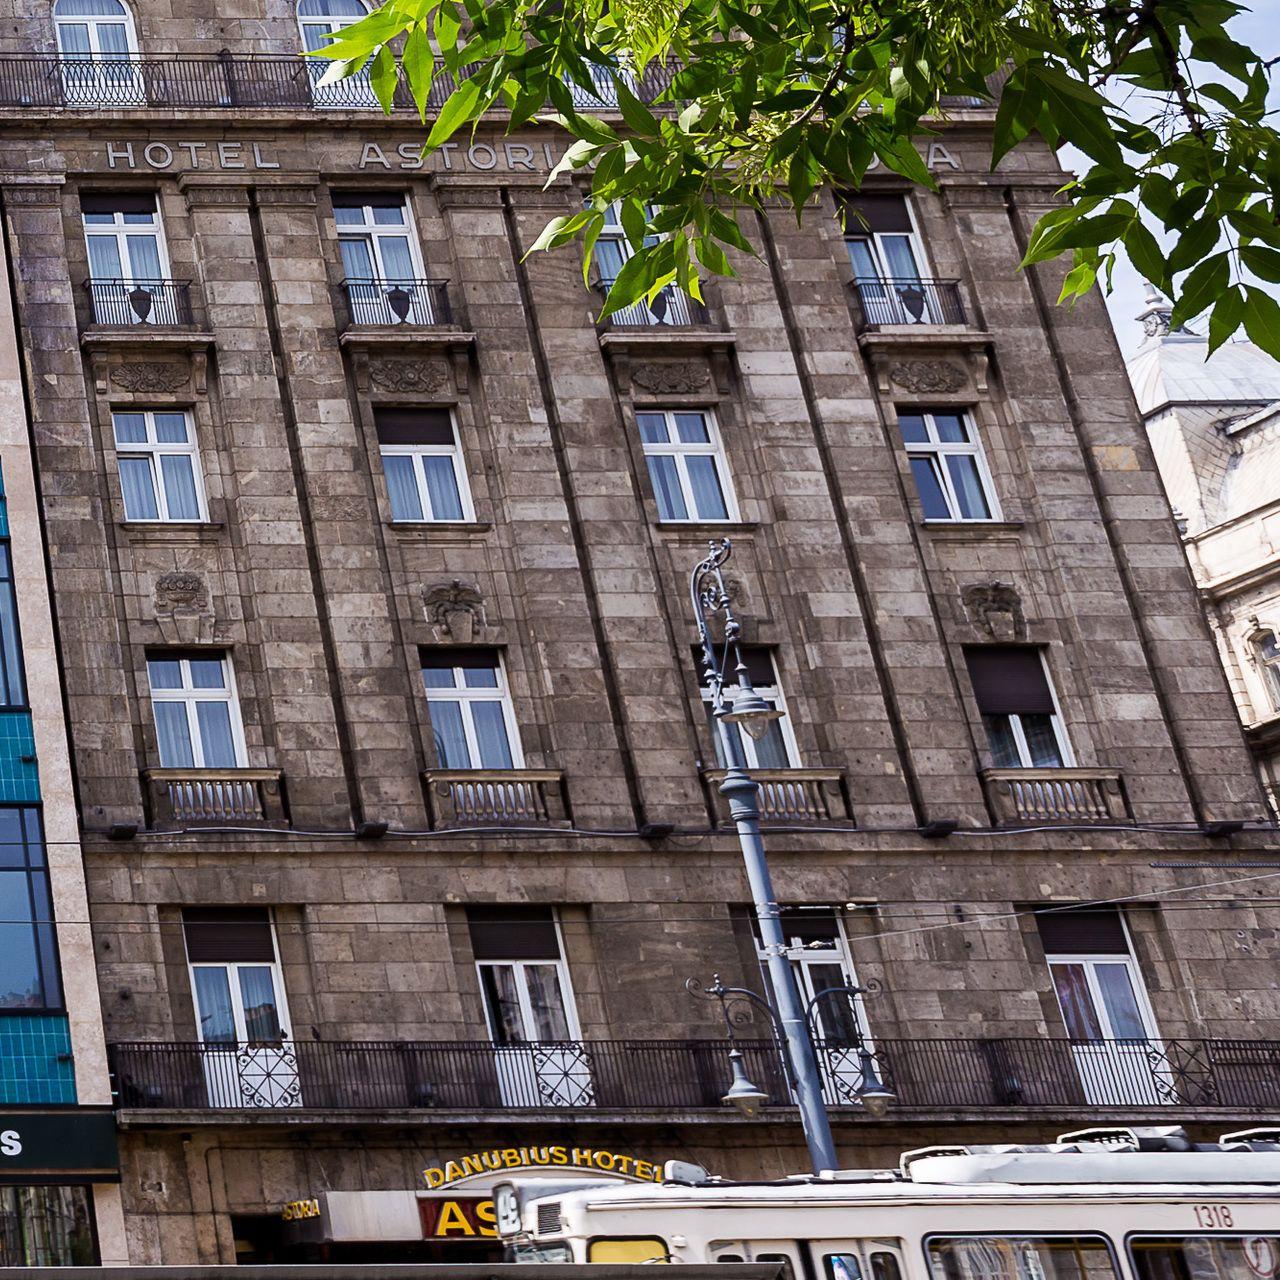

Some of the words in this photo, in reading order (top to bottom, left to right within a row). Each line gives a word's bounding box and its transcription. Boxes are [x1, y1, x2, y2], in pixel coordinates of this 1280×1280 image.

[106, 141, 280, 169] HOTEL
[359, 141, 597, 170] ASTORI
[422, 1146, 567, 1189] DANUBIUS
[1193, 1205, 1234, 1228] 1318
